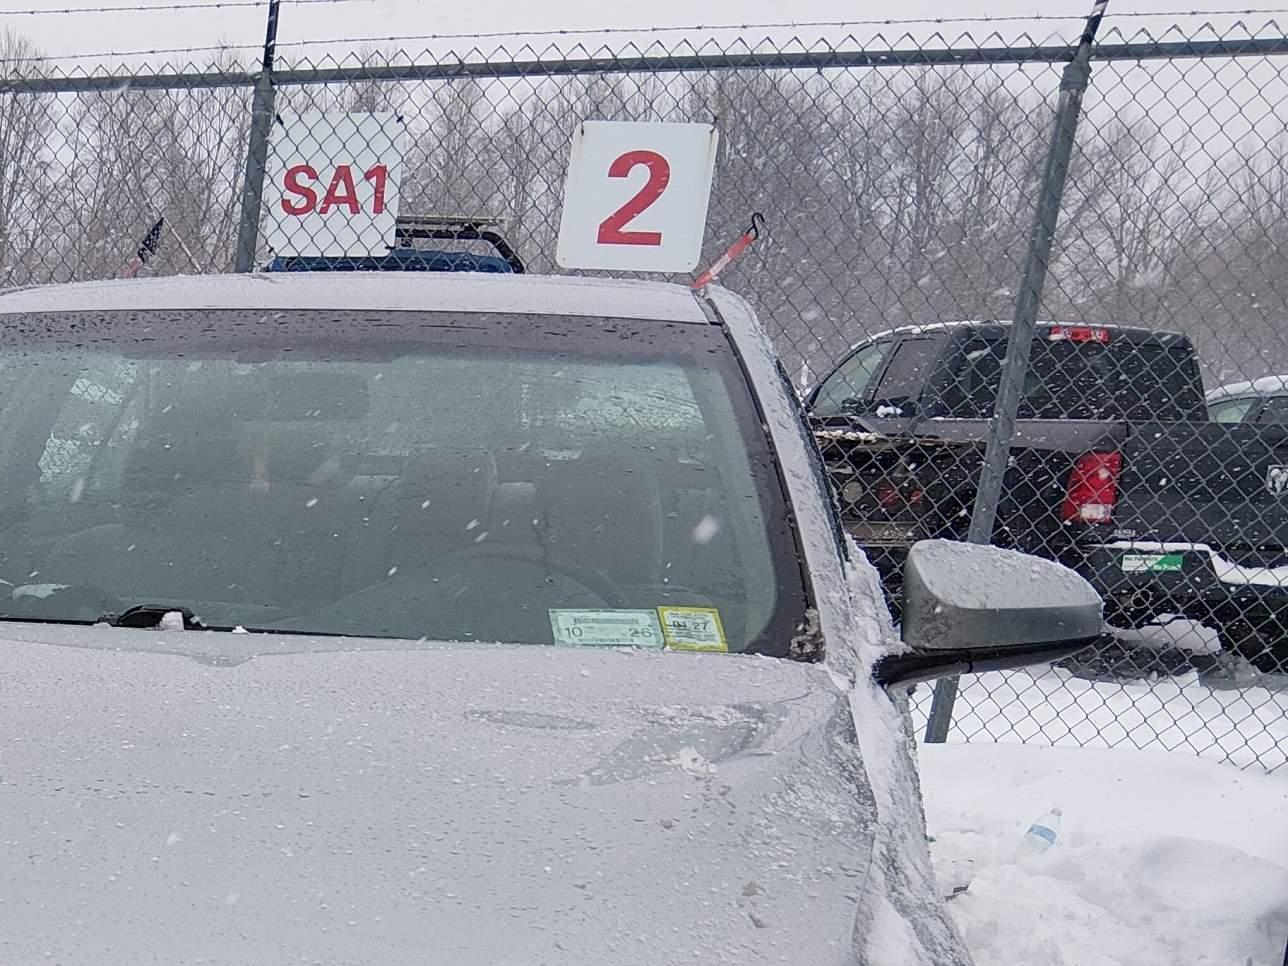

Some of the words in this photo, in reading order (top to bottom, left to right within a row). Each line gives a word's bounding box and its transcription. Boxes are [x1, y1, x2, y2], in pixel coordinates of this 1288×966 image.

[281, 164, 388, 216] SA1
[596, 149, 671, 247] 2
[565, 626, 583, 638] 10
[691, 621, 710, 631] 27
[628, 627, 652, 638] 26
